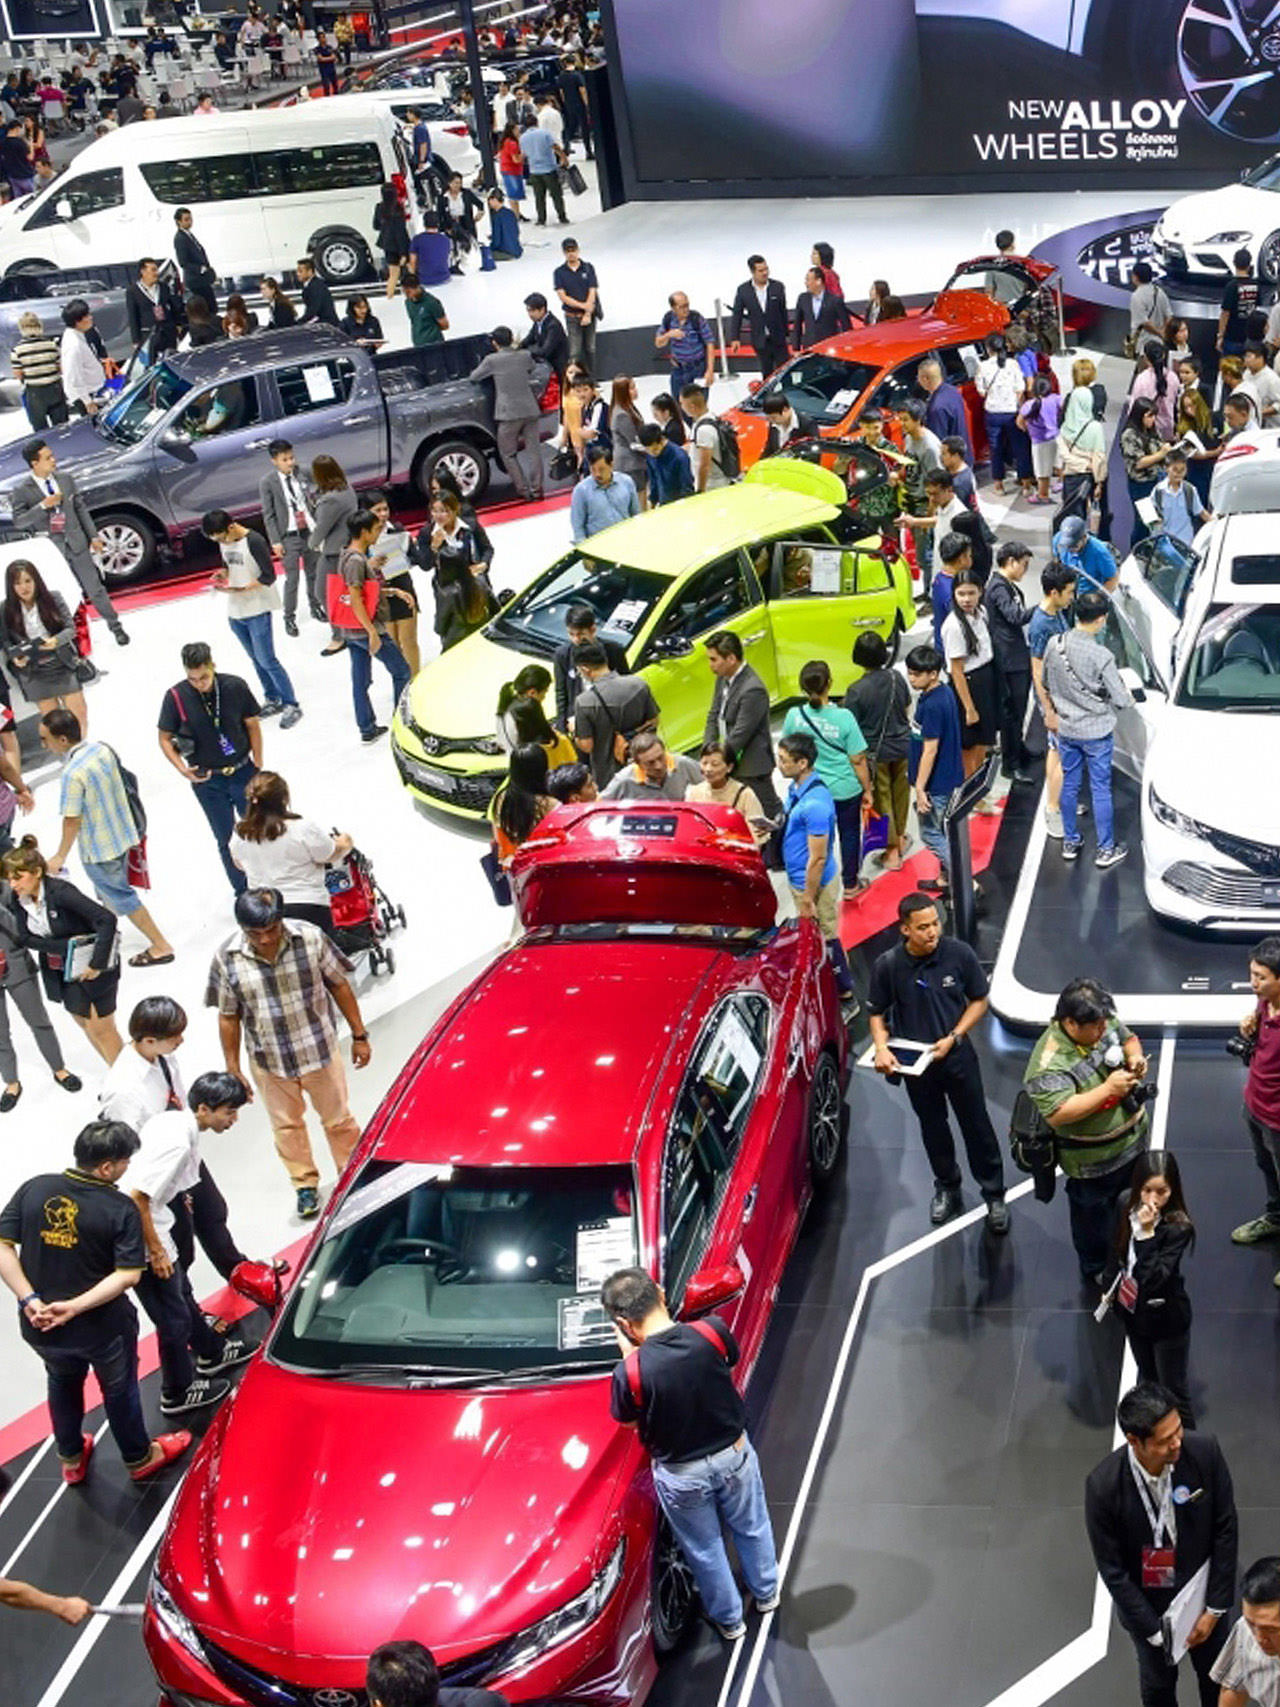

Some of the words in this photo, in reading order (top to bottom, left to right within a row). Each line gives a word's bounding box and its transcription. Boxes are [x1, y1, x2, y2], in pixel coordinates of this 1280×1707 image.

[1008, 100, 1064, 119] NEW
[1060, 99, 1187, 130] ALLOY
[973, 132, 1118, 160] WHEELS
